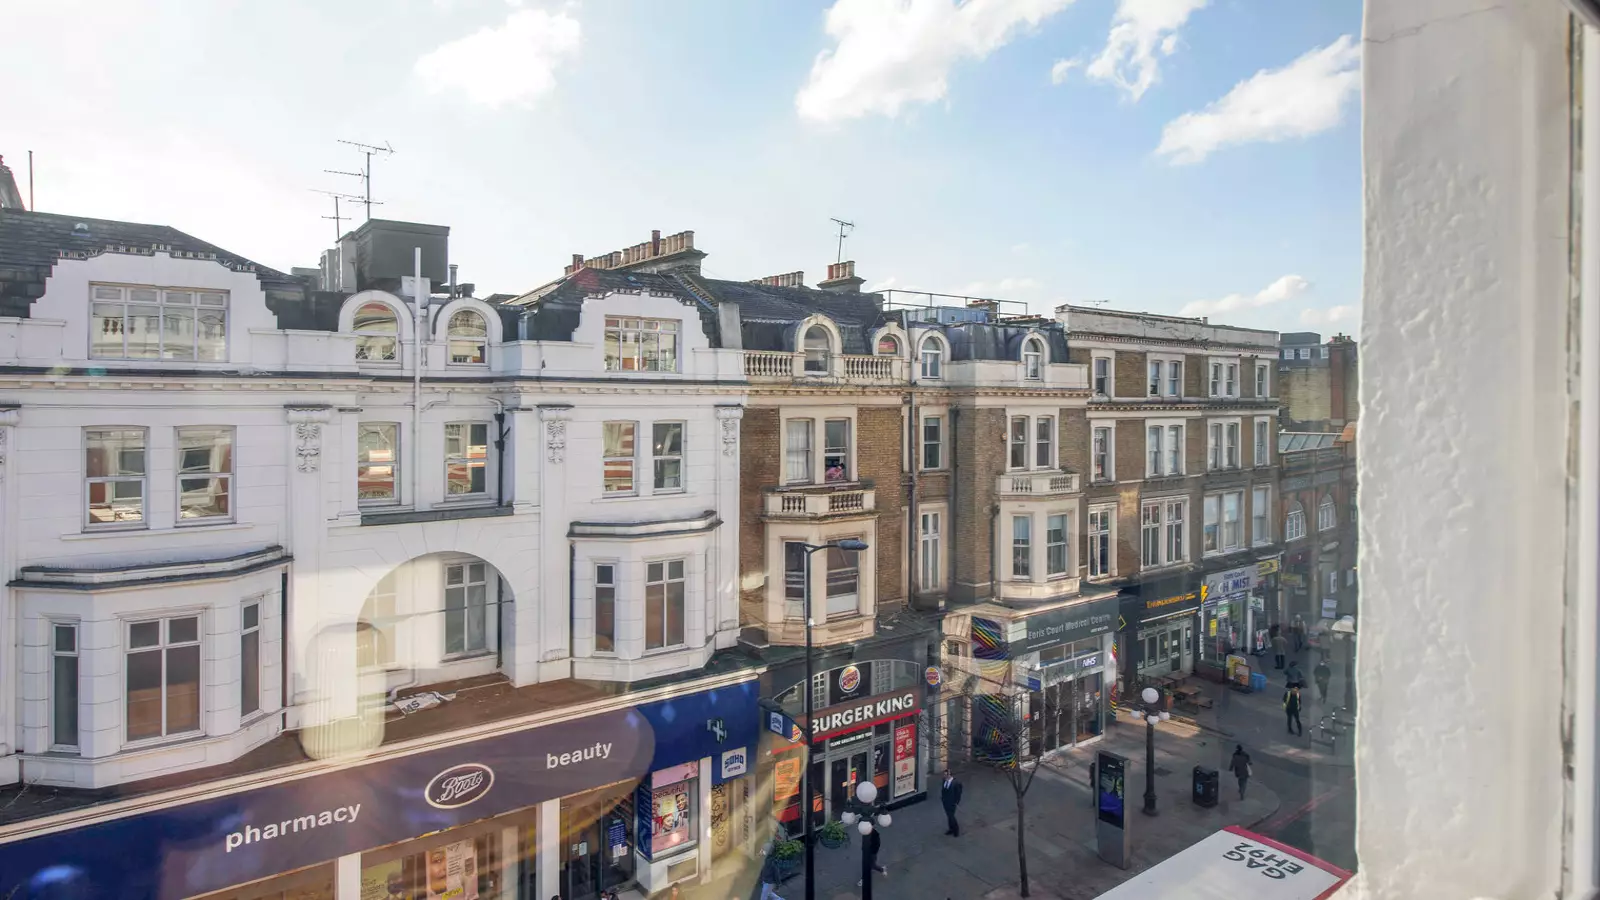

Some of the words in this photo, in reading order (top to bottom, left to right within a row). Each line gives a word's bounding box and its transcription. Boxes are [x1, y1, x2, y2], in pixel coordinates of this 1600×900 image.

[1046, 623, 1064, 636] Court
[1065, 618, 1089, 631] Medical
[1082, 656, 1096, 667] NHS
[812, 704, 874, 735] BURGER
[876, 693, 914, 717] KING
[546, 740, 613, 770] beauty
[724, 754, 744, 769] SOHO
[436, 770, 484, 803] Boots
[652, 783, 685, 799] beautiful
[225, 803, 362, 853] pharmacy
